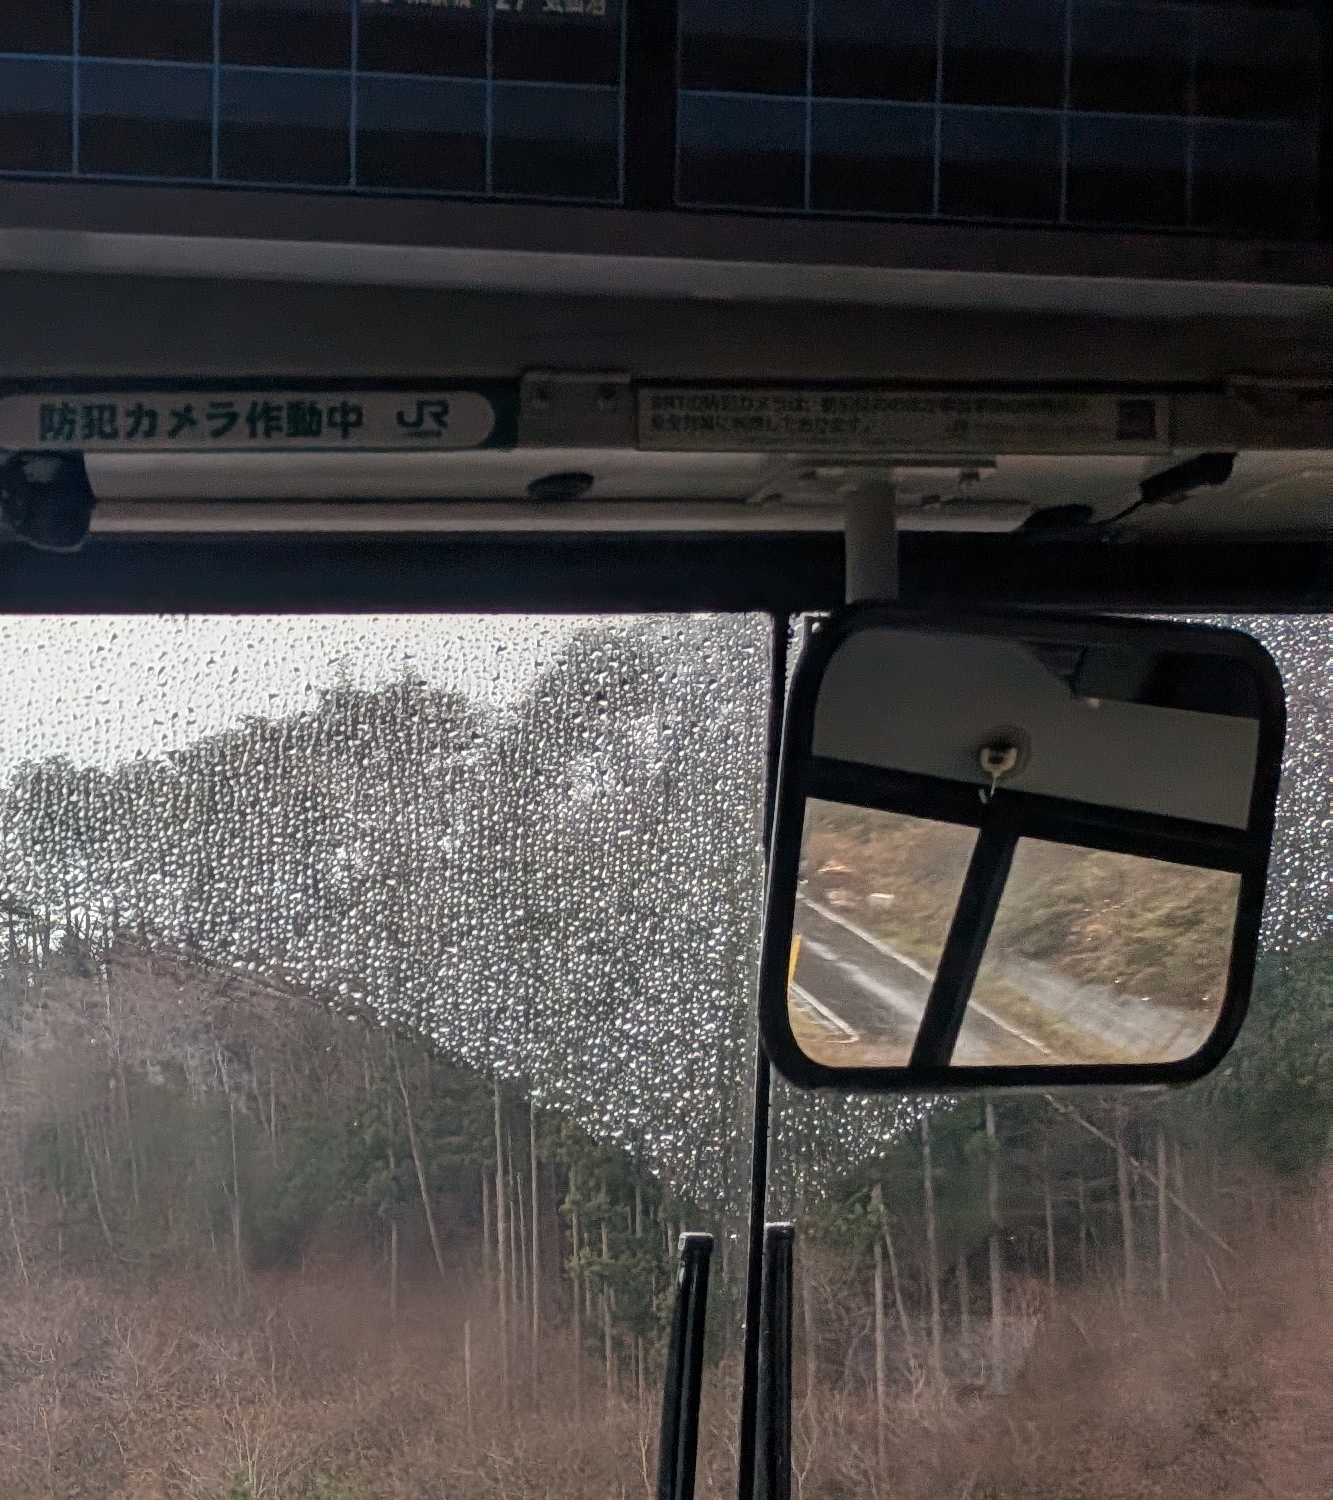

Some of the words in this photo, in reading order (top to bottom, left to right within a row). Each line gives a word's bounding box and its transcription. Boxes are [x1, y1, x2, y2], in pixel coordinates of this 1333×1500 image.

[37, 400, 364, 442] 防犯カメラ作動中
[395, 399, 450, 429] JR
